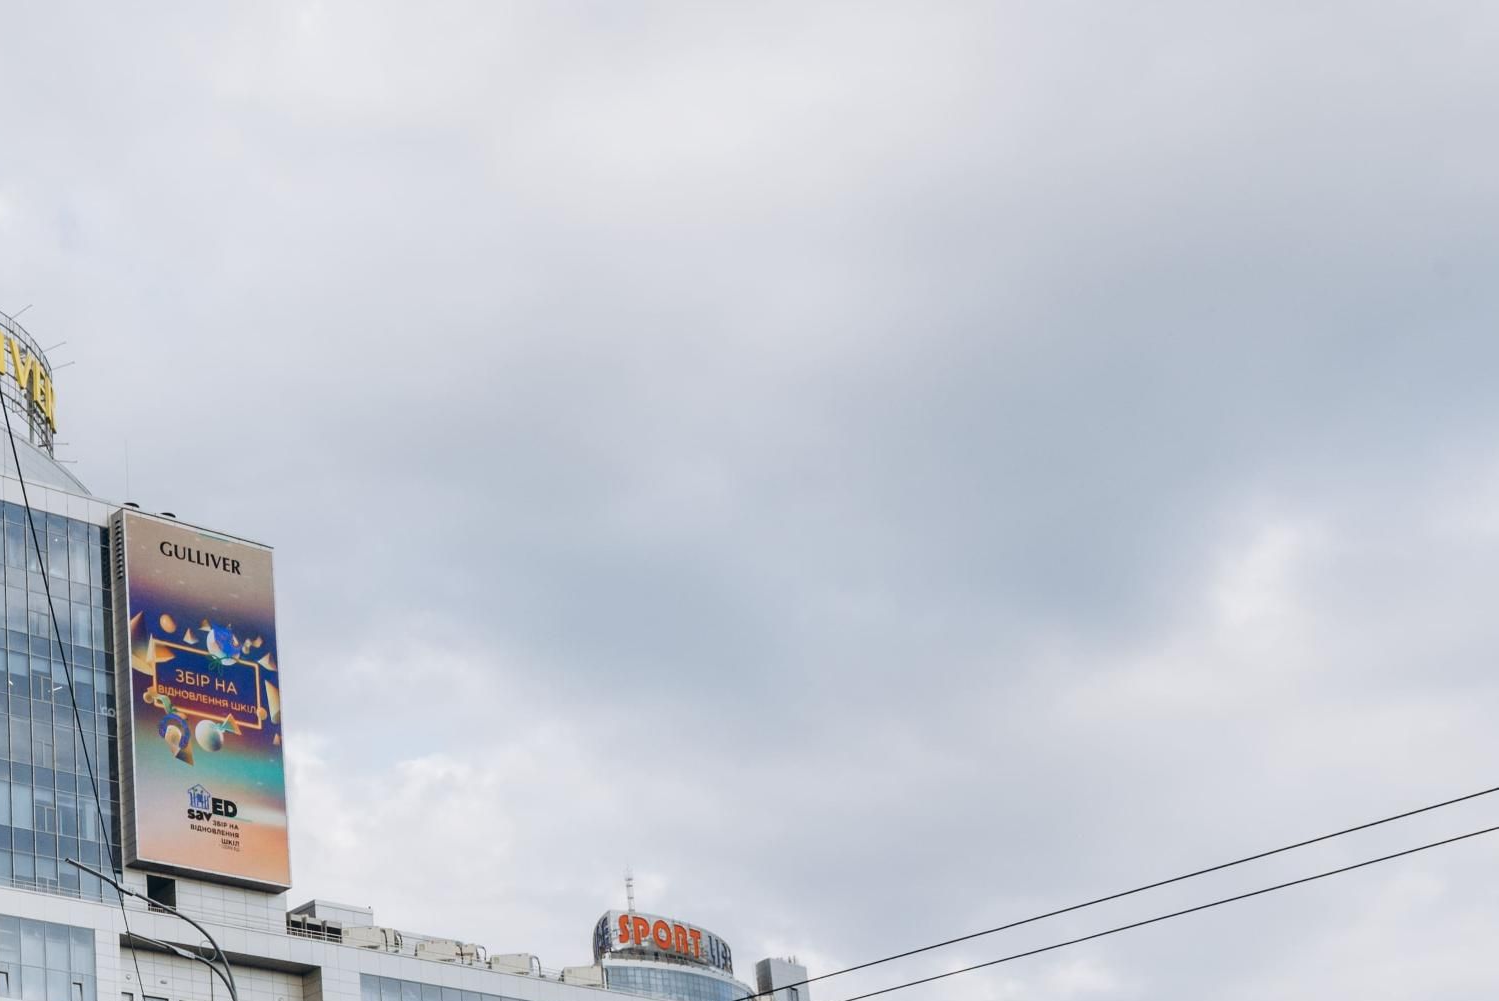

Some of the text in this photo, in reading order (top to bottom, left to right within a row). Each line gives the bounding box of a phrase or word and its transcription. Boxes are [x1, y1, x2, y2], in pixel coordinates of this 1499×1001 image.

[159, 540, 241, 575] GULLIVER
[175, 669, 238, 695] ЗБІР НА
[158, 685, 257, 715] ВІДНОВЛЕННЯ ШКІЛ
[190, 824, 240, 839] ВІДНОВЛЕННЯ
[212, 820, 240, 831] ЗБІР НА
[221, 838, 240, 847] ШКІЛ
[618, 914, 702, 959] SPORT
